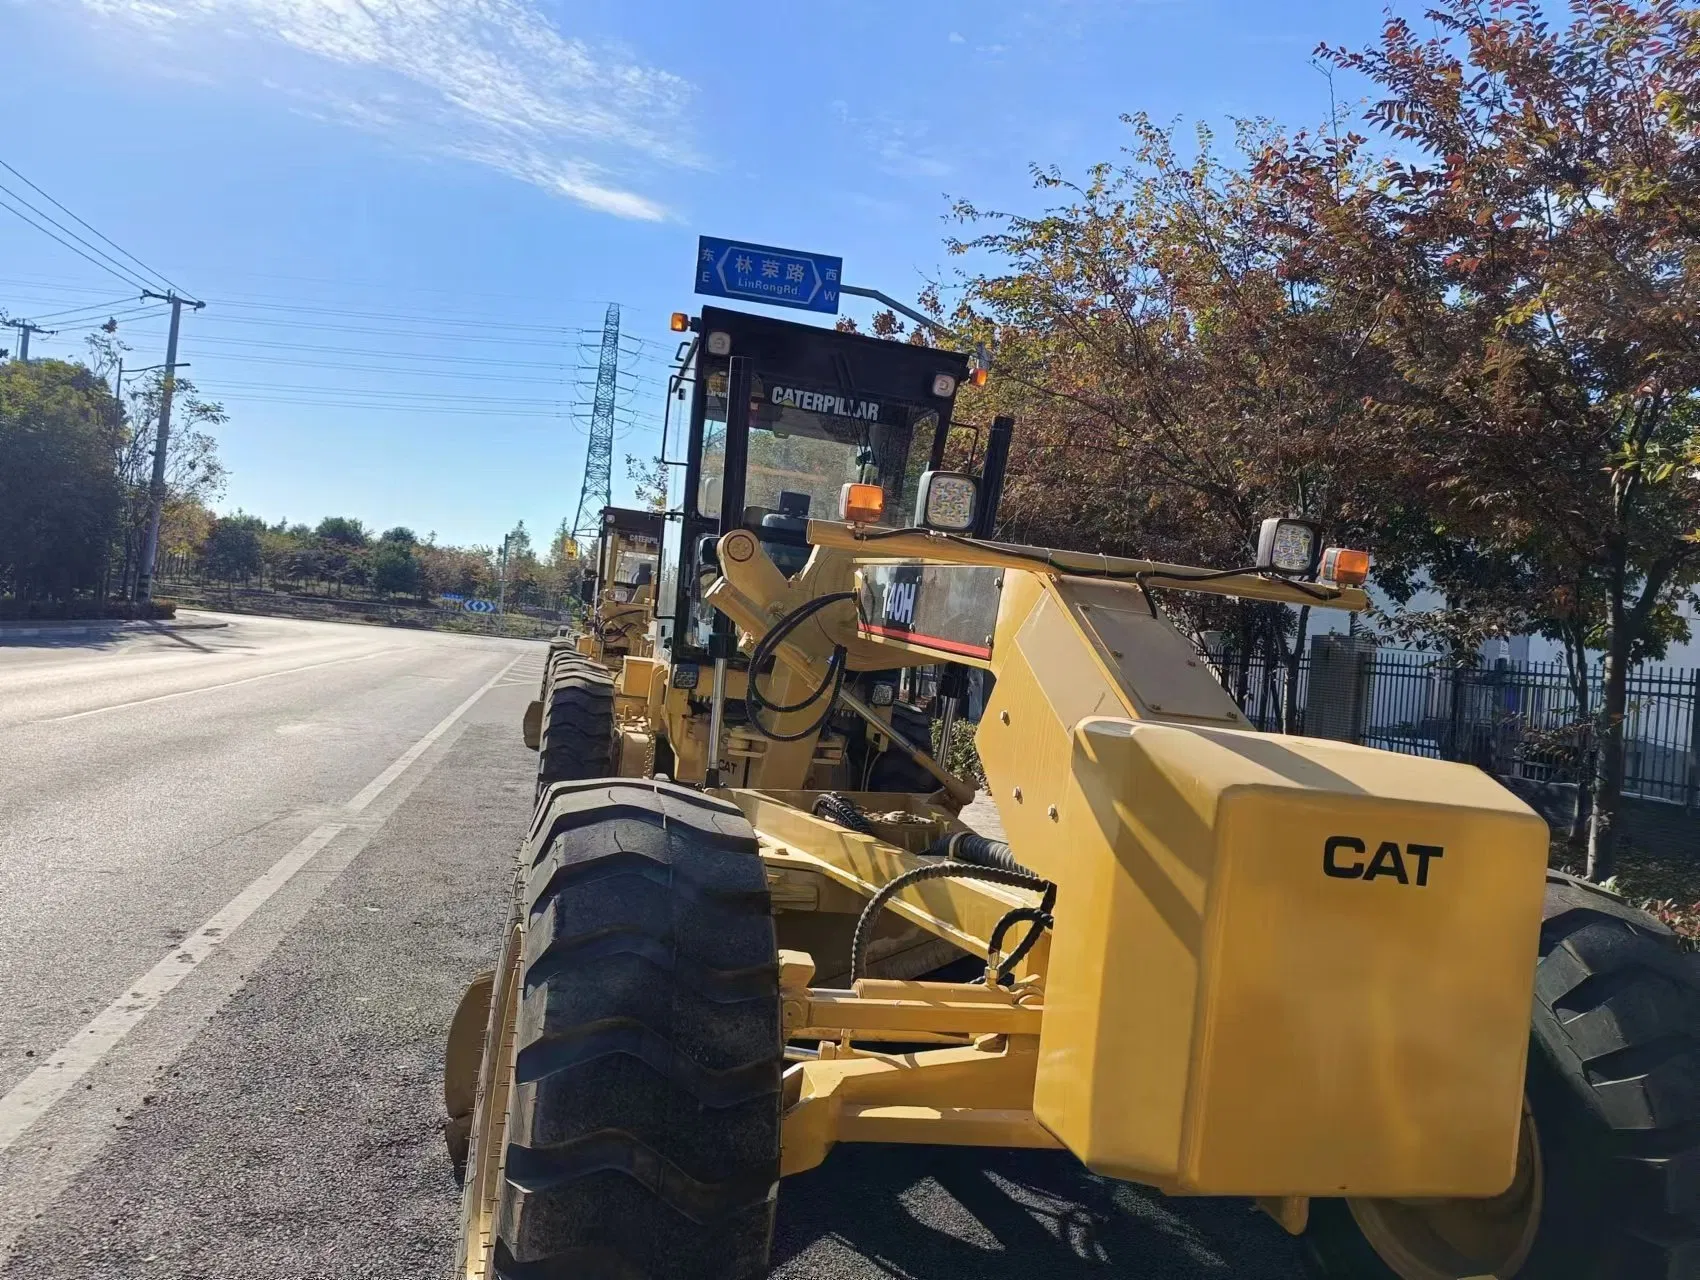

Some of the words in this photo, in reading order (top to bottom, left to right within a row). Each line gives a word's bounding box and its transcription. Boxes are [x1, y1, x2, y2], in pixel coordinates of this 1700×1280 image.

[702, 248, 714, 262] 东
[702, 271, 711, 282] E
[735, 255, 805, 282] 林荣路
[825, 268, 837, 281] 西
[824, 290, 836, 301] W
[771, 386, 880, 421] CATERPILLAR
[881, 582, 916, 624] 140H
[719, 759, 738, 775] CAT
[1323, 835, 1444, 887] CAT
